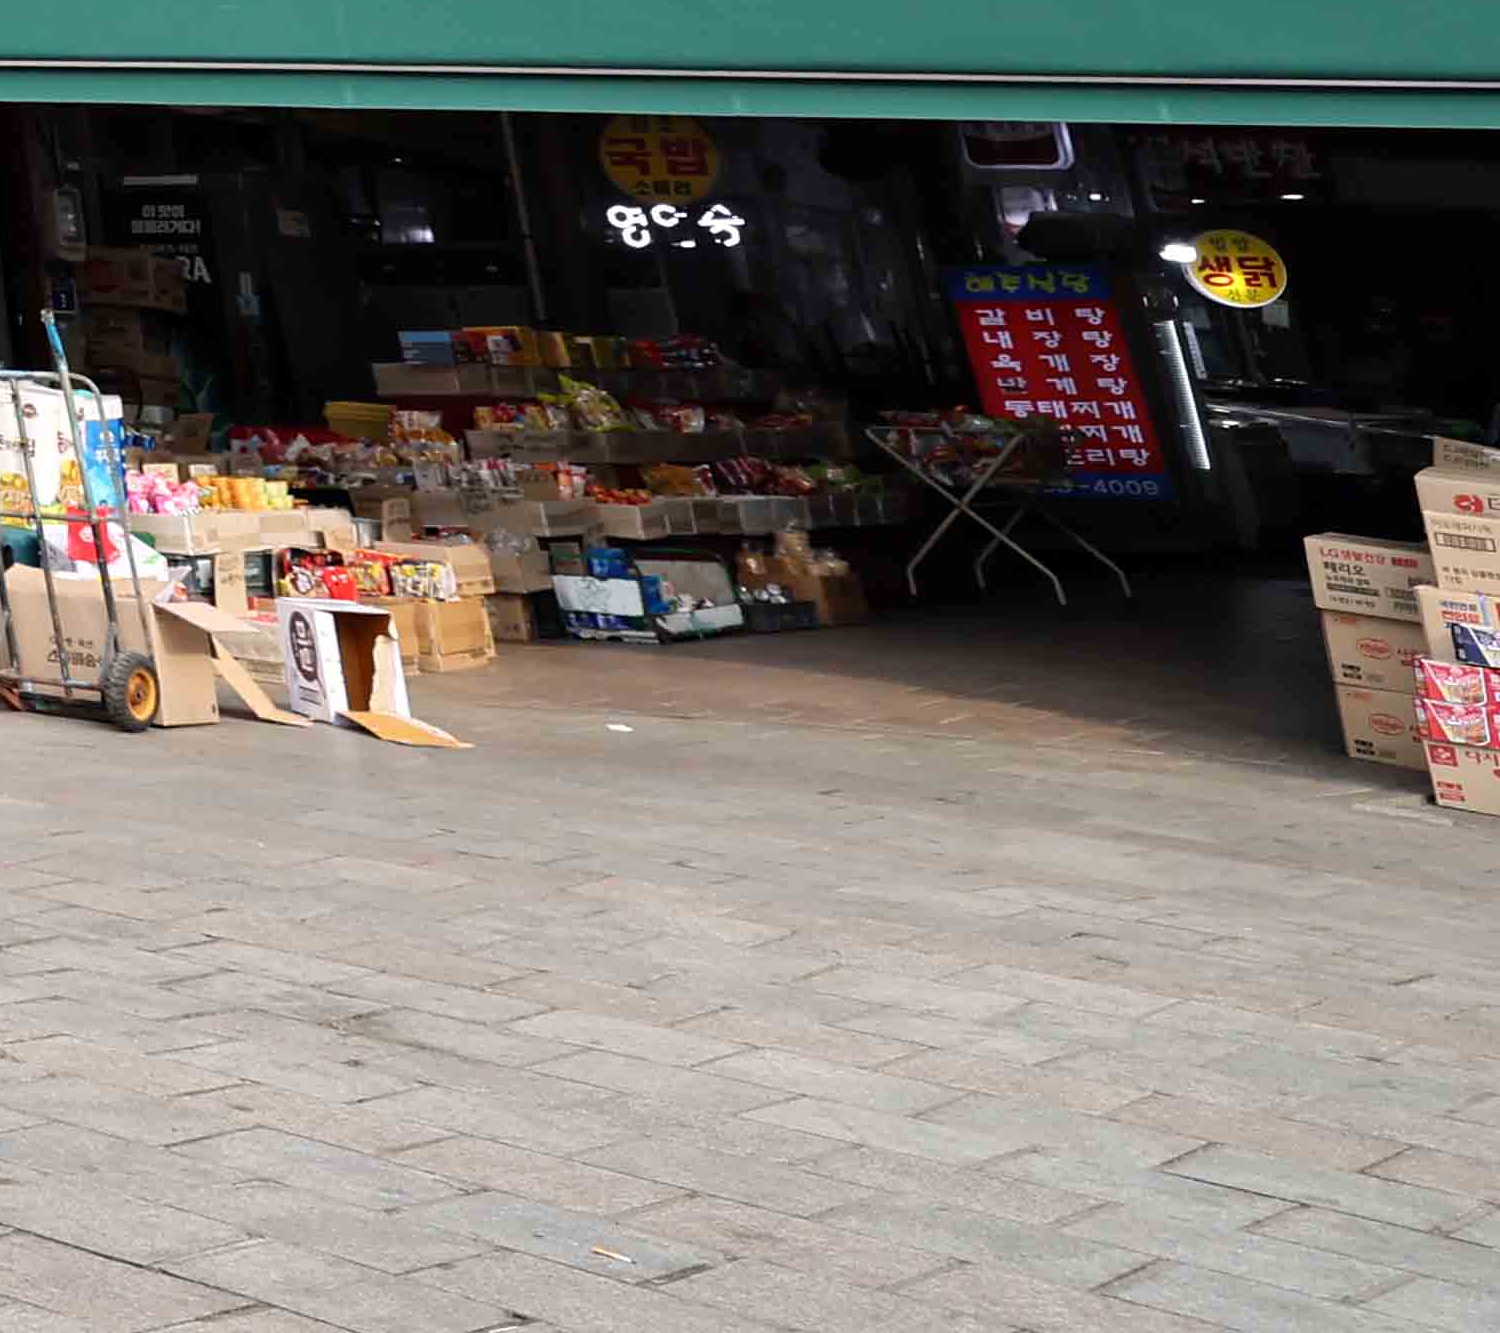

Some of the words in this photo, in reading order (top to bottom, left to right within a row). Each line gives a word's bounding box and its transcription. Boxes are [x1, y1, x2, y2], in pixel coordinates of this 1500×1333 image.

[603, 136, 710, 176] 국밥
[1196, 253, 1278, 289] 생닭
[974, 307, 1107, 326] 갈비탕
[982, 330, 1114, 349] 내장탕
[990, 353, 1121, 372] 육개장
[1003, 399, 1137, 420] 동태찌개
